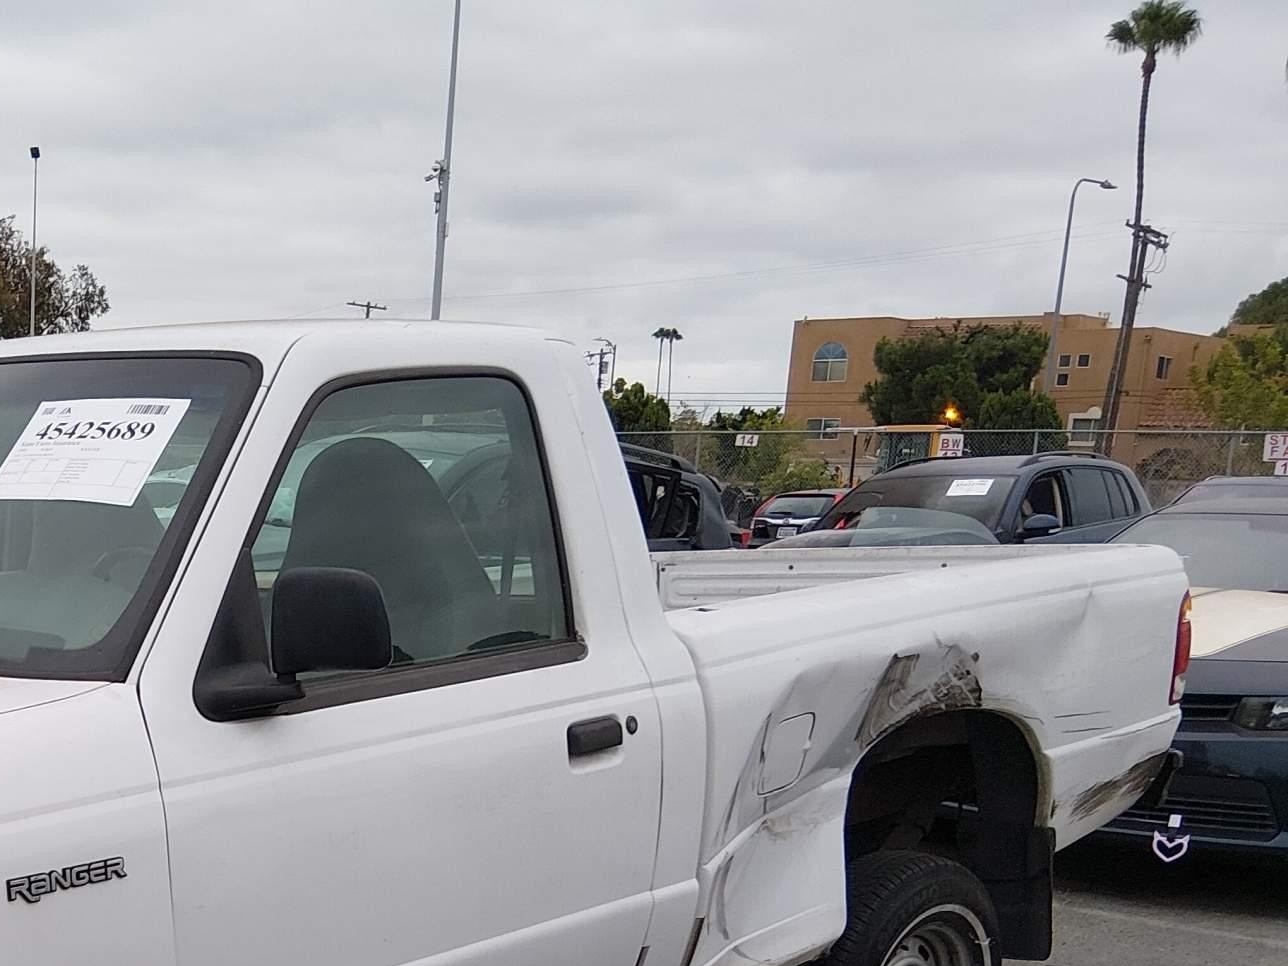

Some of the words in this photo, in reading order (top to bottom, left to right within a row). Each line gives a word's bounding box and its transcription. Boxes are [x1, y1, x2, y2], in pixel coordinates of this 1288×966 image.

[35, 421, 155, 440] 45425689
[740, 435, 754, 446] 14
[6, 856, 127, 904] RANGER
